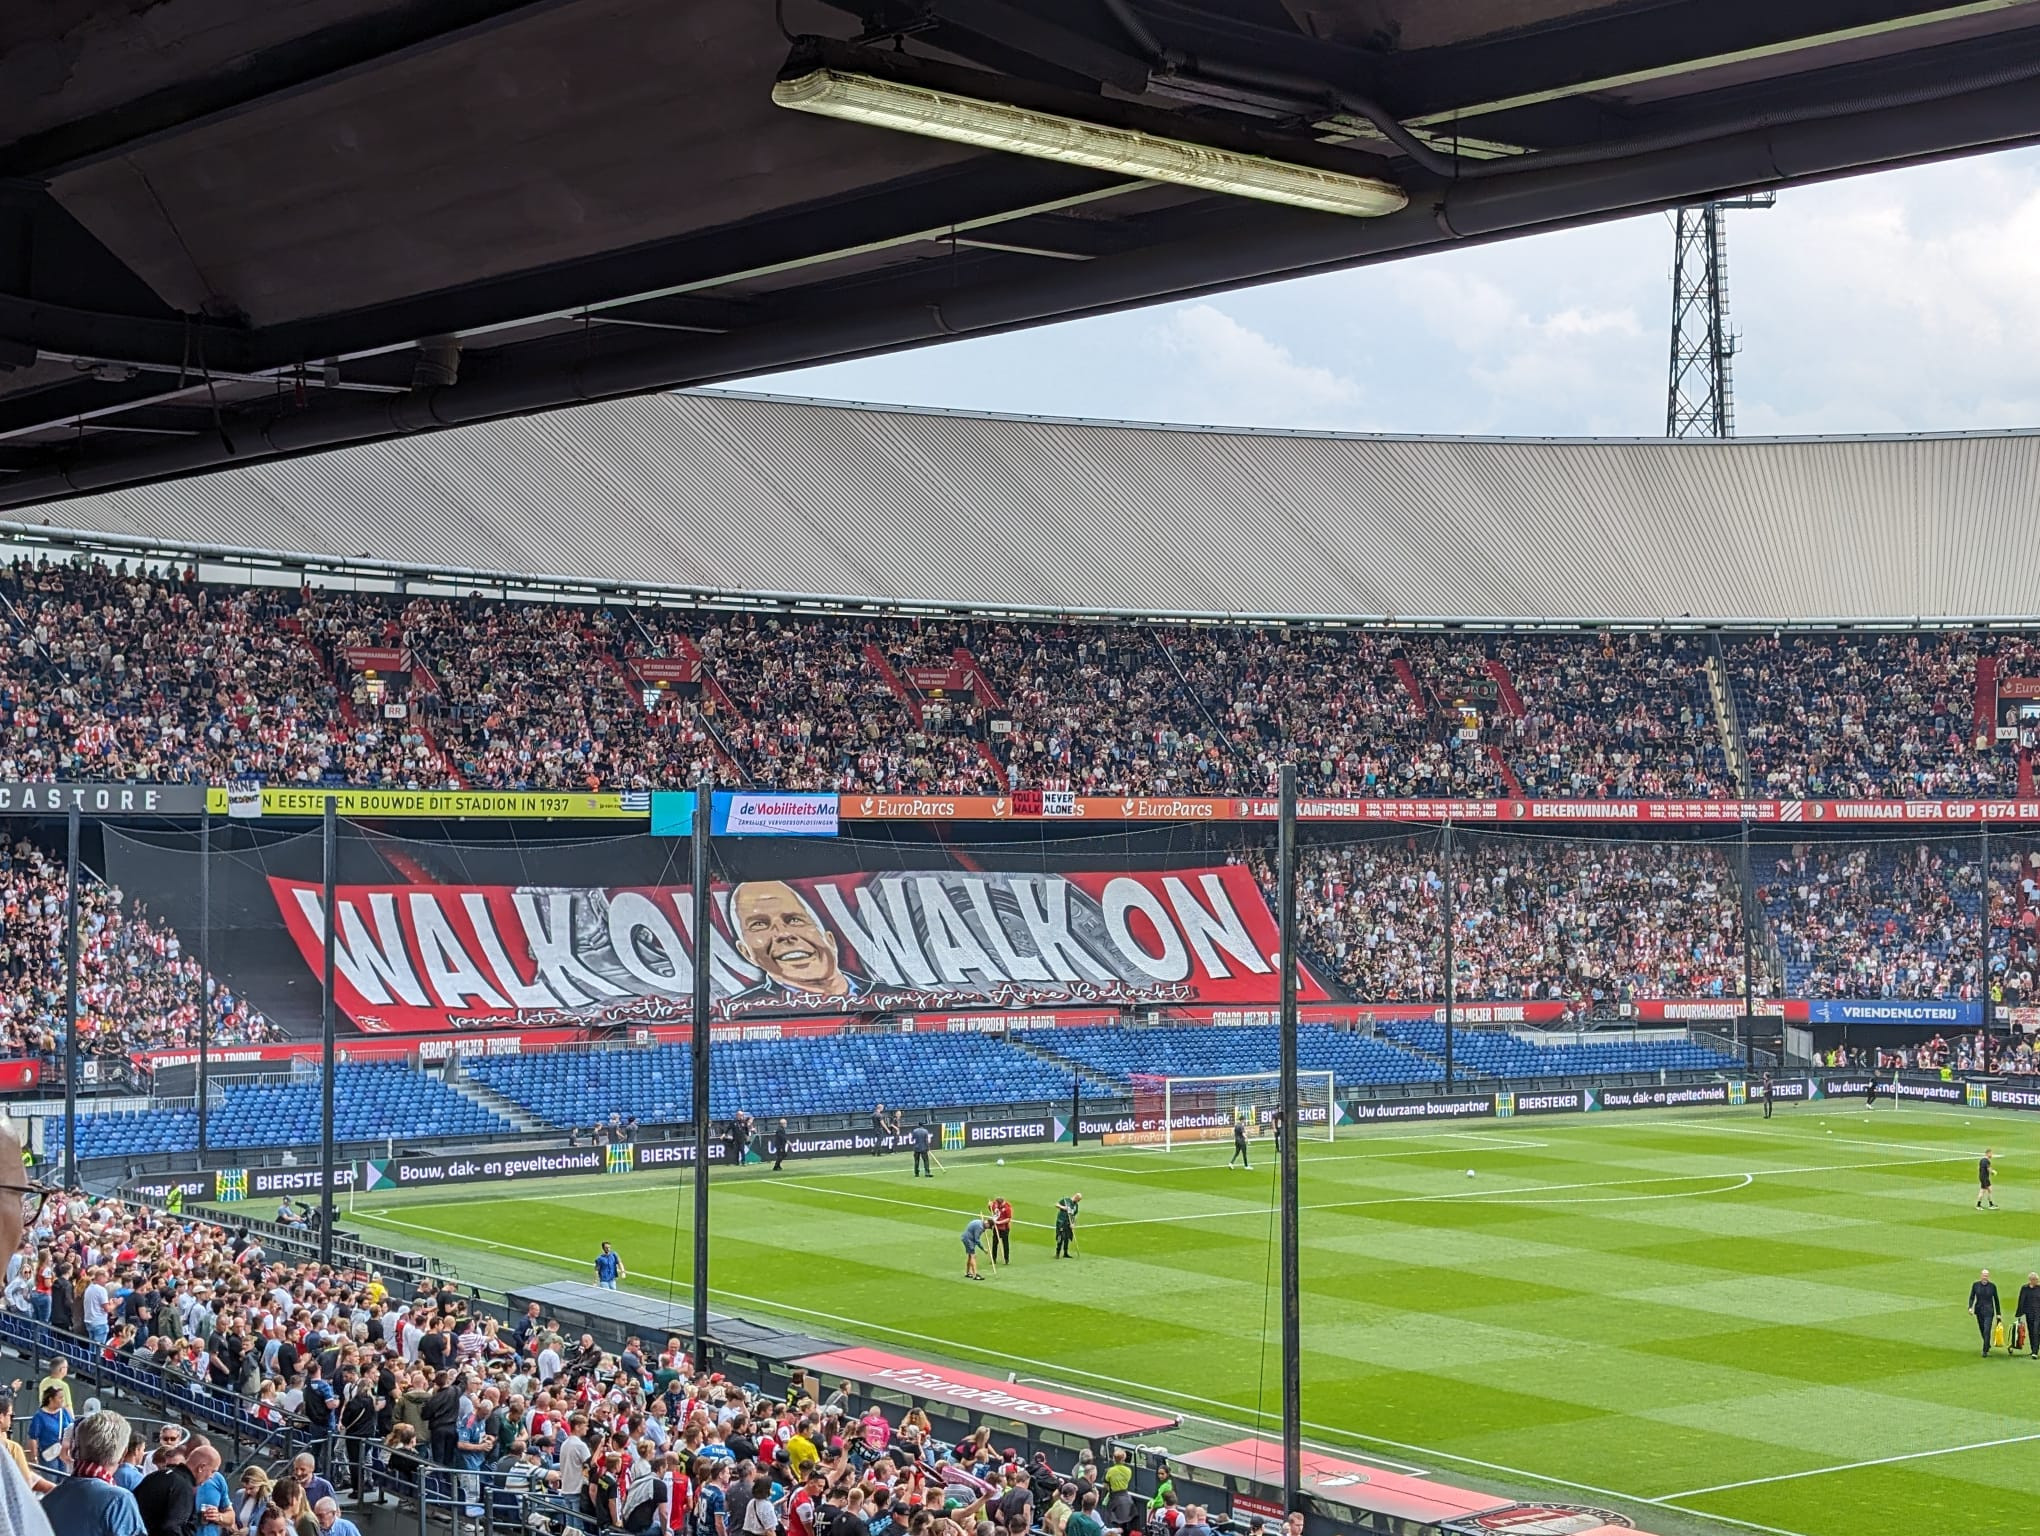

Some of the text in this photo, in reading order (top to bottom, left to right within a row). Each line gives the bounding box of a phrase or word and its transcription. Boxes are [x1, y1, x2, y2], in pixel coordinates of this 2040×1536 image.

[388, 707, 401, 715] RR
[0, 788, 157, 812] CASTORE
[279, 795, 354, 810] EESTEEN
[360, 796, 424, 810] BOUWDE
[430, 797, 452, 810] DIT
[456, 797, 519, 811] STADION
[522, 798, 535, 811] IN
[541, 798, 569, 812] 1937
[1045, 793, 1074, 803] NEVER
[877, 800, 954, 816] EuroParcs
[1013, 804, 1041, 814] WALK
[1044, 804, 1072, 814] ALONE
[1138, 801, 1212, 816] EuroParcs
[1254, 803, 1359, 817] LANKAMPIOEN
[1533, 803, 1638, 817] BEKERWINNAAR
[1836, 804, 2039, 818] WINNAAR UEFA CUP 1974 EN
[292, 886, 630, 1009] WALK
[815, 876, 1114, 987] WALK
[720, 992, 865, 1017] prachtige
[992, 983, 1065, 1001] Arne
[1494, 1007, 1524, 1021] TRIBUNE
[1842, 1006, 1957, 1020] VRIENDENLOTERIJ
[1998, 1008, 2006, 1017] V
[487, 1037, 521, 1055] TRIBUNE
[1604, 1087, 1725, 1106] Bouw, dak- en geveltechniek
[1828, 1081, 1841, 1093] Uw
[1898, 1080, 1960, 1099] bouwpartner
[1358, 1100, 1490, 1118] Uw duurzame bouwpartner
[1519, 1095, 1578, 1110] BIERSTEKER
[971, 1123, 1045, 1142] BIERSTEKER
[1079, 1121, 1112, 1134] Bouw,
[1116, 1118, 1140, 1131] dak-
[791, 1137, 852, 1153] duurzame
[640, 1144, 725, 1163] BIERSTEER
[400, 1152, 600, 1181] Bouw, dak- en geveltechniek
[256, 1170, 354, 1191] BIERSTEER
[895, 1373, 1064, 1415] EuroParcs
